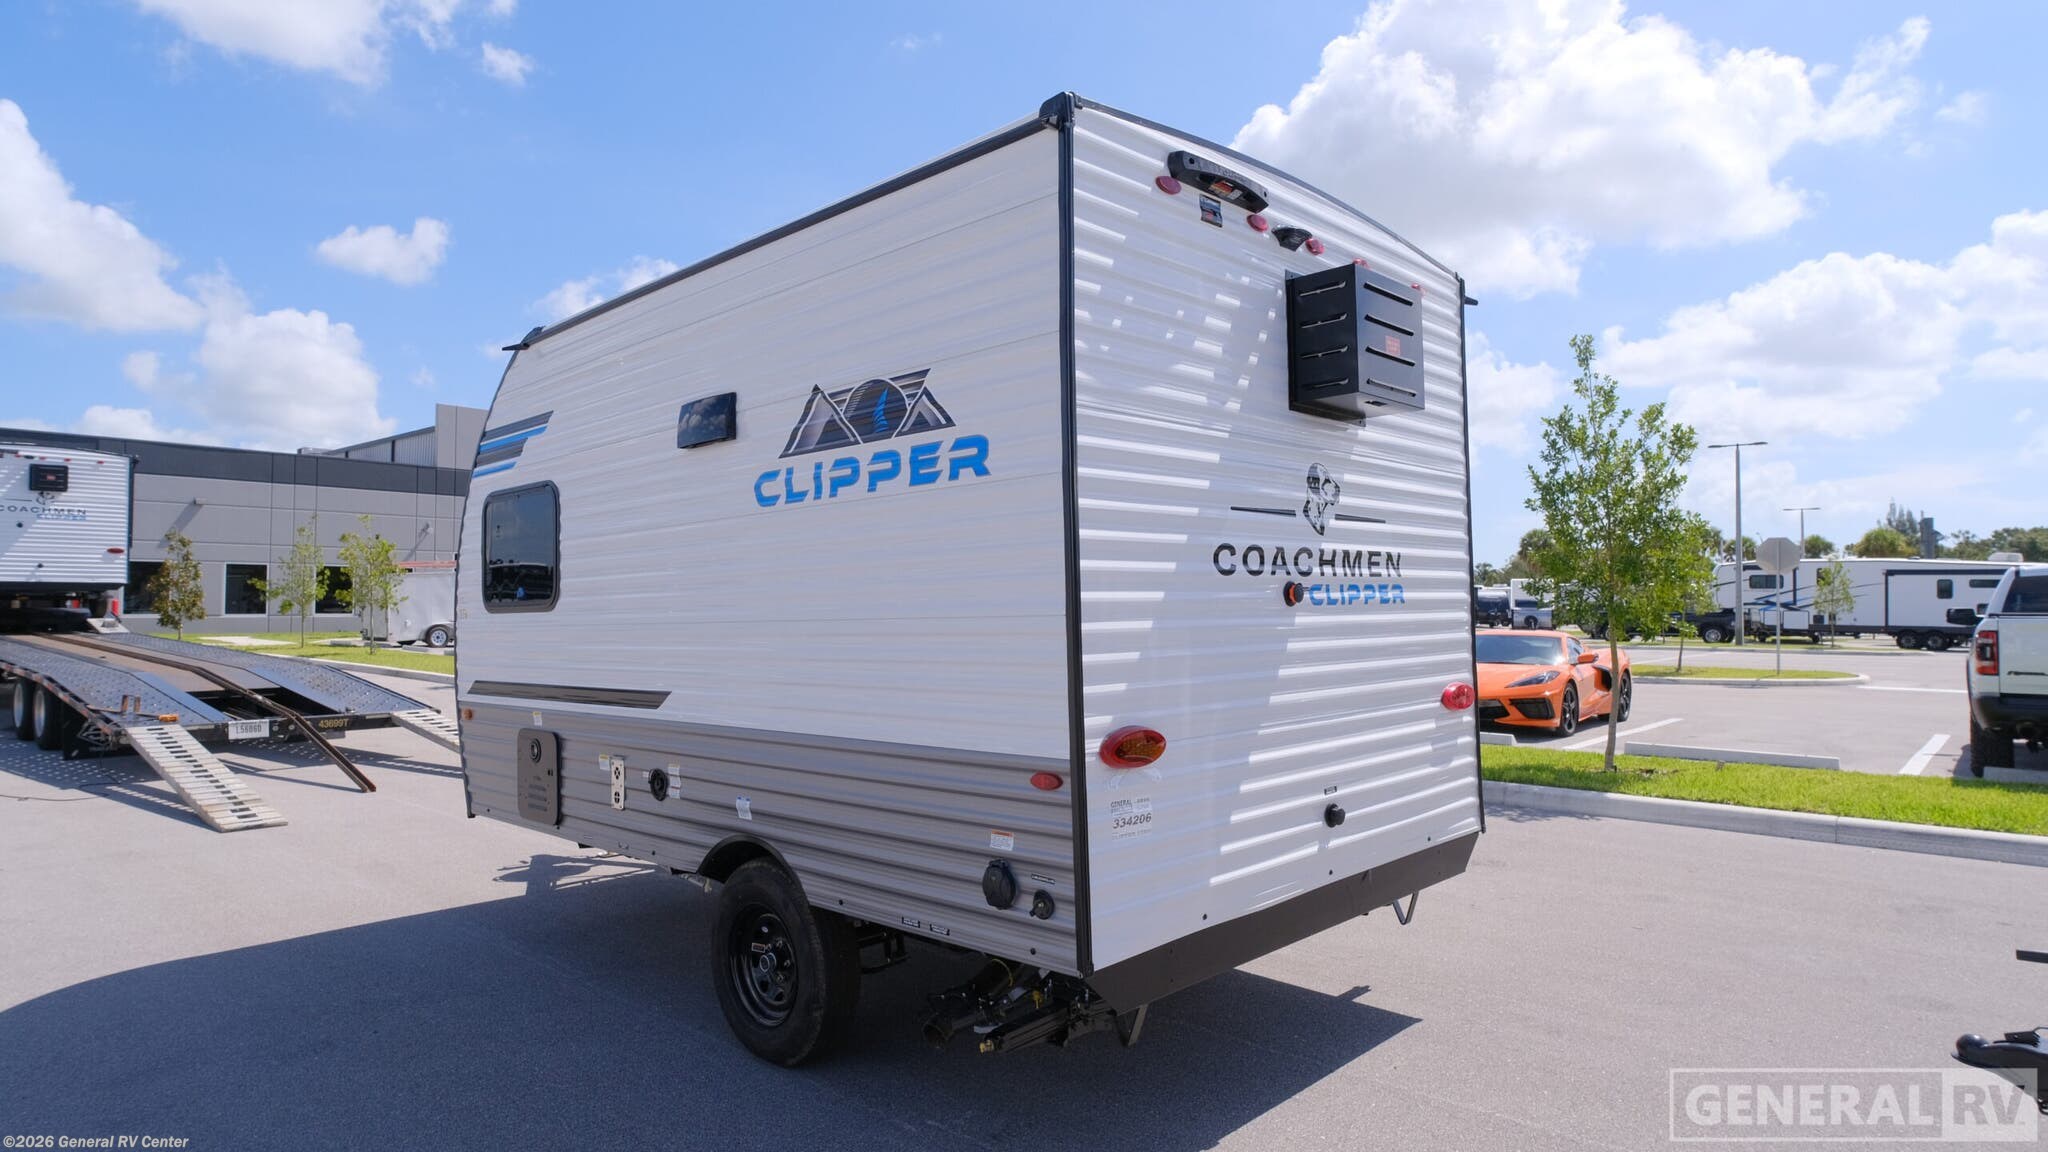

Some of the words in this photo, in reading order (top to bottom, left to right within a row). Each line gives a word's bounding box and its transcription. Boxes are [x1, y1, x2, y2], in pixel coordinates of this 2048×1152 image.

[753, 434, 991, 507] CLIPPER
[1213, 543, 1402, 577] COACHMEN
[1309, 584, 1406, 606] CLIPPER
[1112, 812, 1152, 829] 334206
